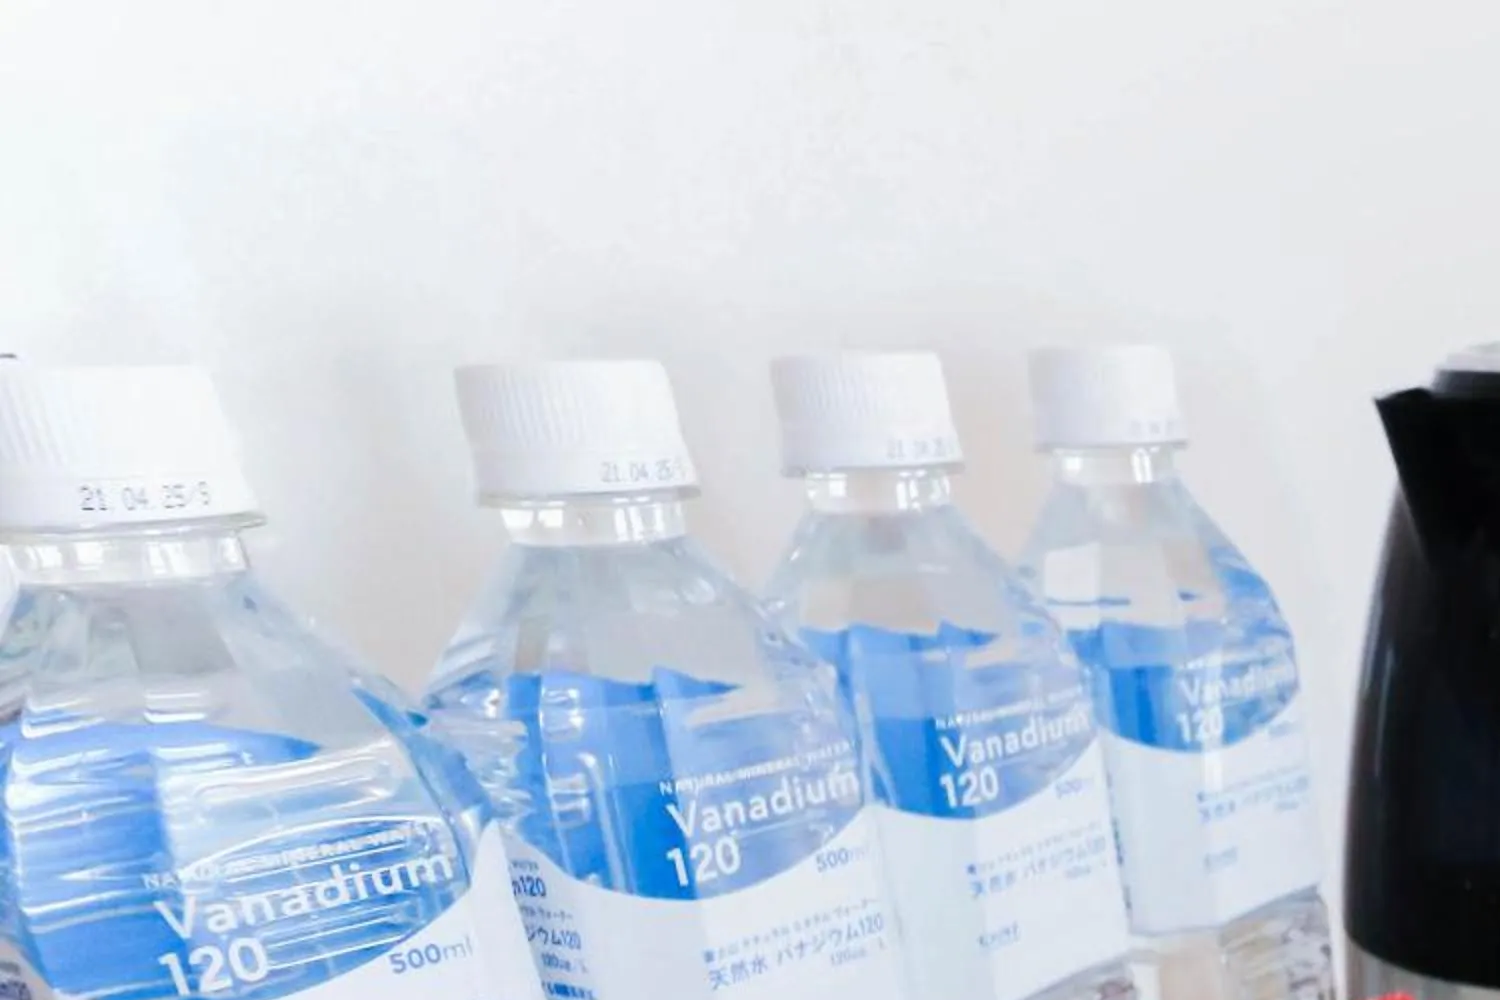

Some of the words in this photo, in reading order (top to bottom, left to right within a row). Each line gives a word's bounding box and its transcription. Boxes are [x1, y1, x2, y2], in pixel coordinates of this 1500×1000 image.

[940, 704, 1091, 768] Vanadium
[666, 768, 861, 838] Vanadium
[940, 764, 999, 808] 120
[666, 835, 742, 887] 120
[153, 853, 453, 940] Vanadium
[158, 937, 270, 996] 120
[389, 936, 472, 975] 500ml
